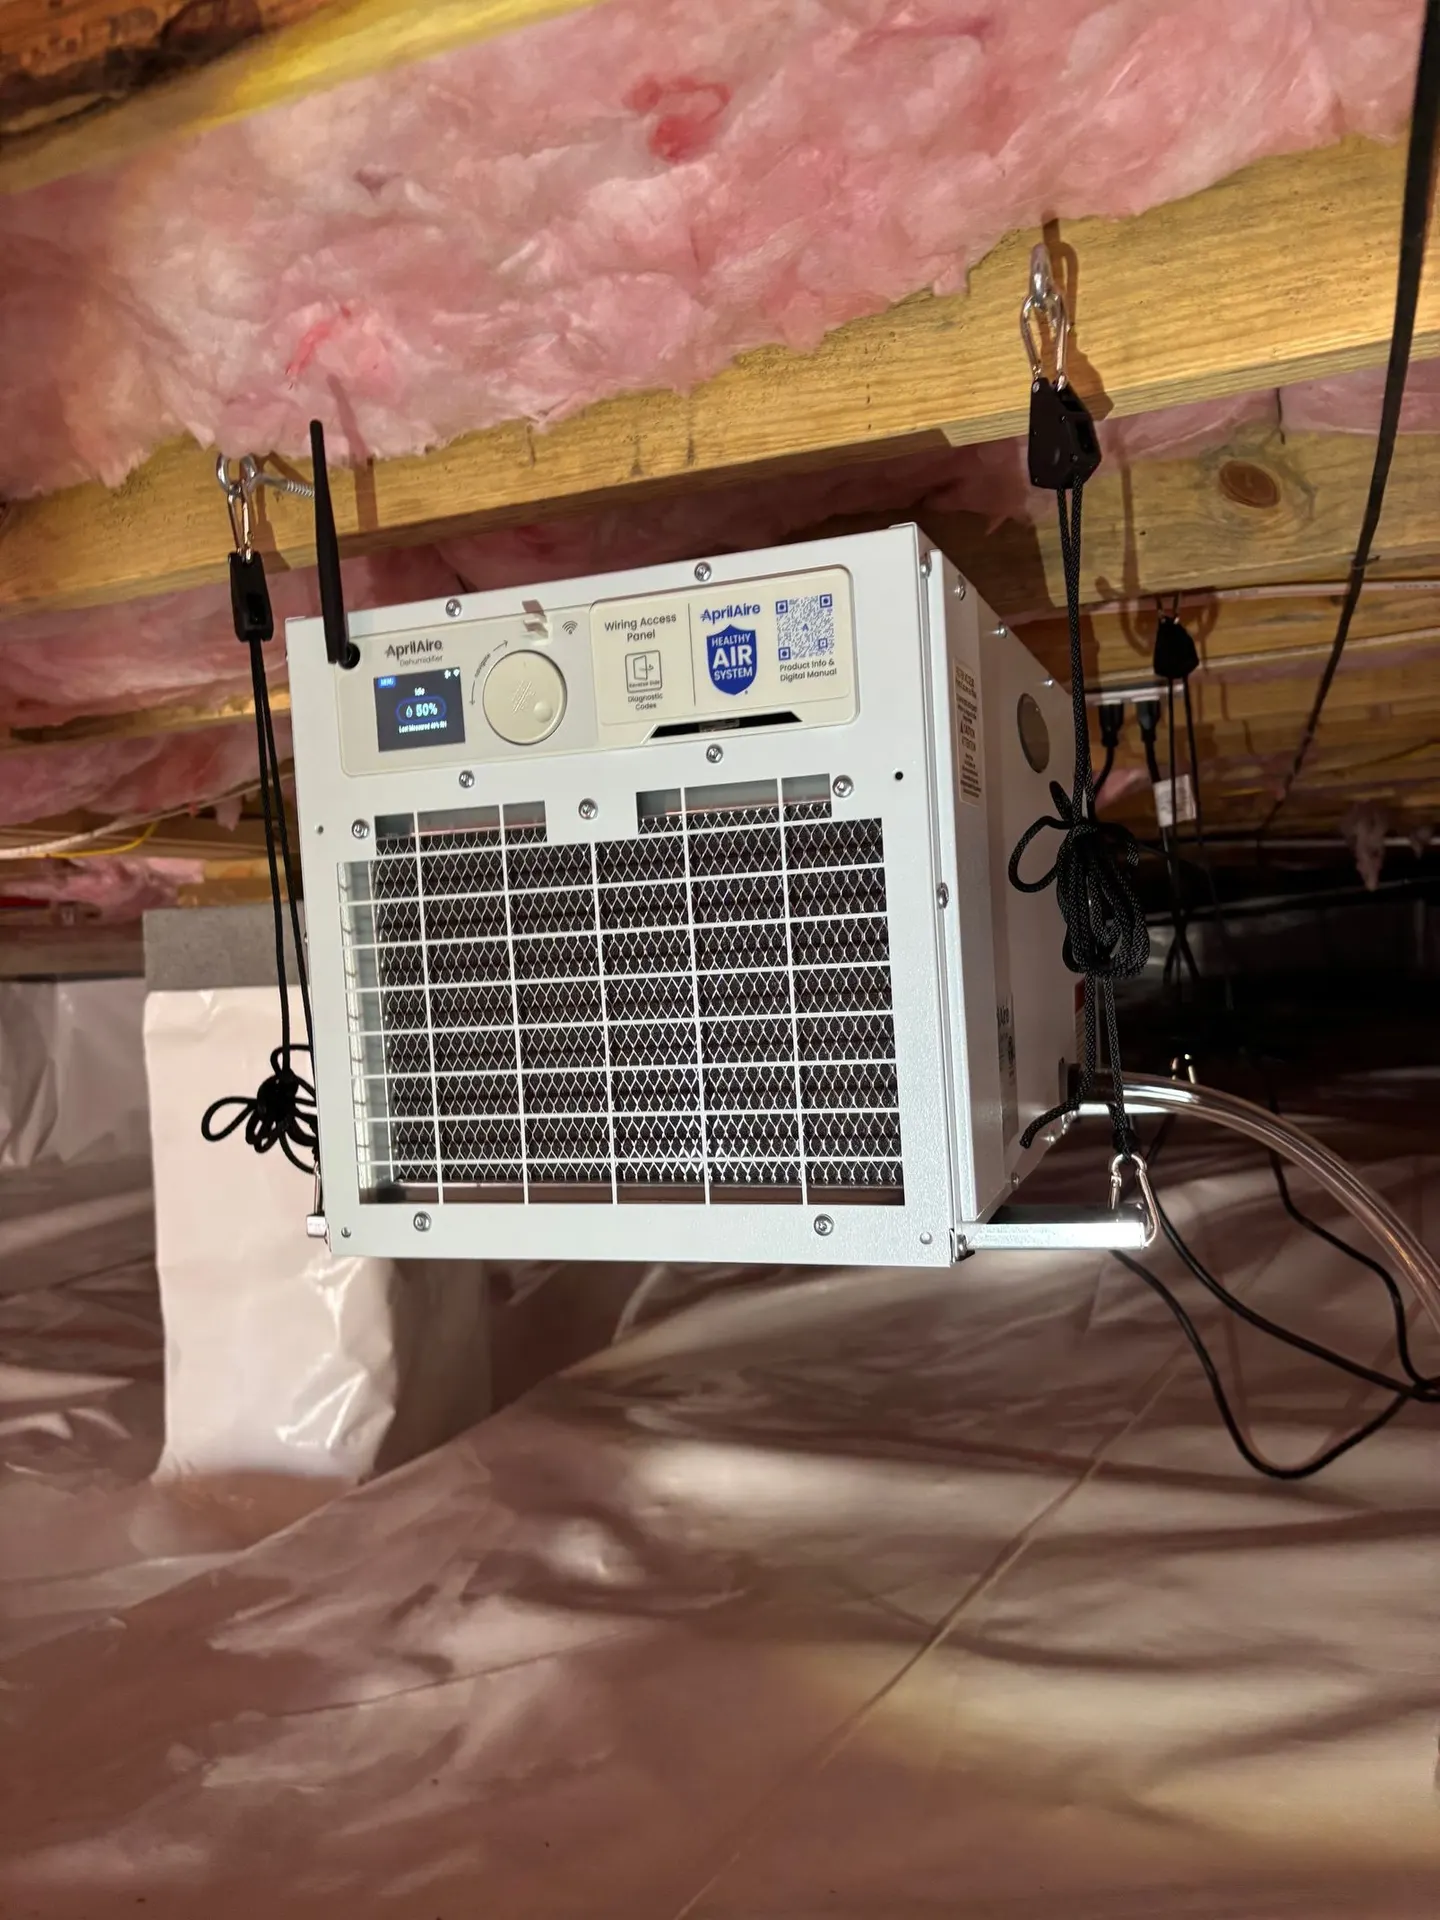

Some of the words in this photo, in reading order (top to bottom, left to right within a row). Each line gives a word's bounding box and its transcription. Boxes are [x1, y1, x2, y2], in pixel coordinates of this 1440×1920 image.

[700, 602, 761, 624] AprilAire
[604, 618, 638, 632] Wiring
[640, 613, 677, 627] Access
[626, 628, 656, 642] Panel
[711, 632, 752, 648] HEALTHY
[385, 639, 443, 661] AprilAire
[712, 645, 753, 669] AIR
[399, 655, 443, 667] Dehumidifier
[779, 661, 810, 672] Product
[811, 658, 827, 668] Info
[828, 658, 835, 666] &
[713, 667, 753, 681] SYSTEM
[780, 670, 806, 683] Digital
[806, 667, 837, 679] Manual
[627, 692, 663, 703] Diagnostic
[415, 702, 438, 717] 50%
[635, 702, 657, 711] Codes
